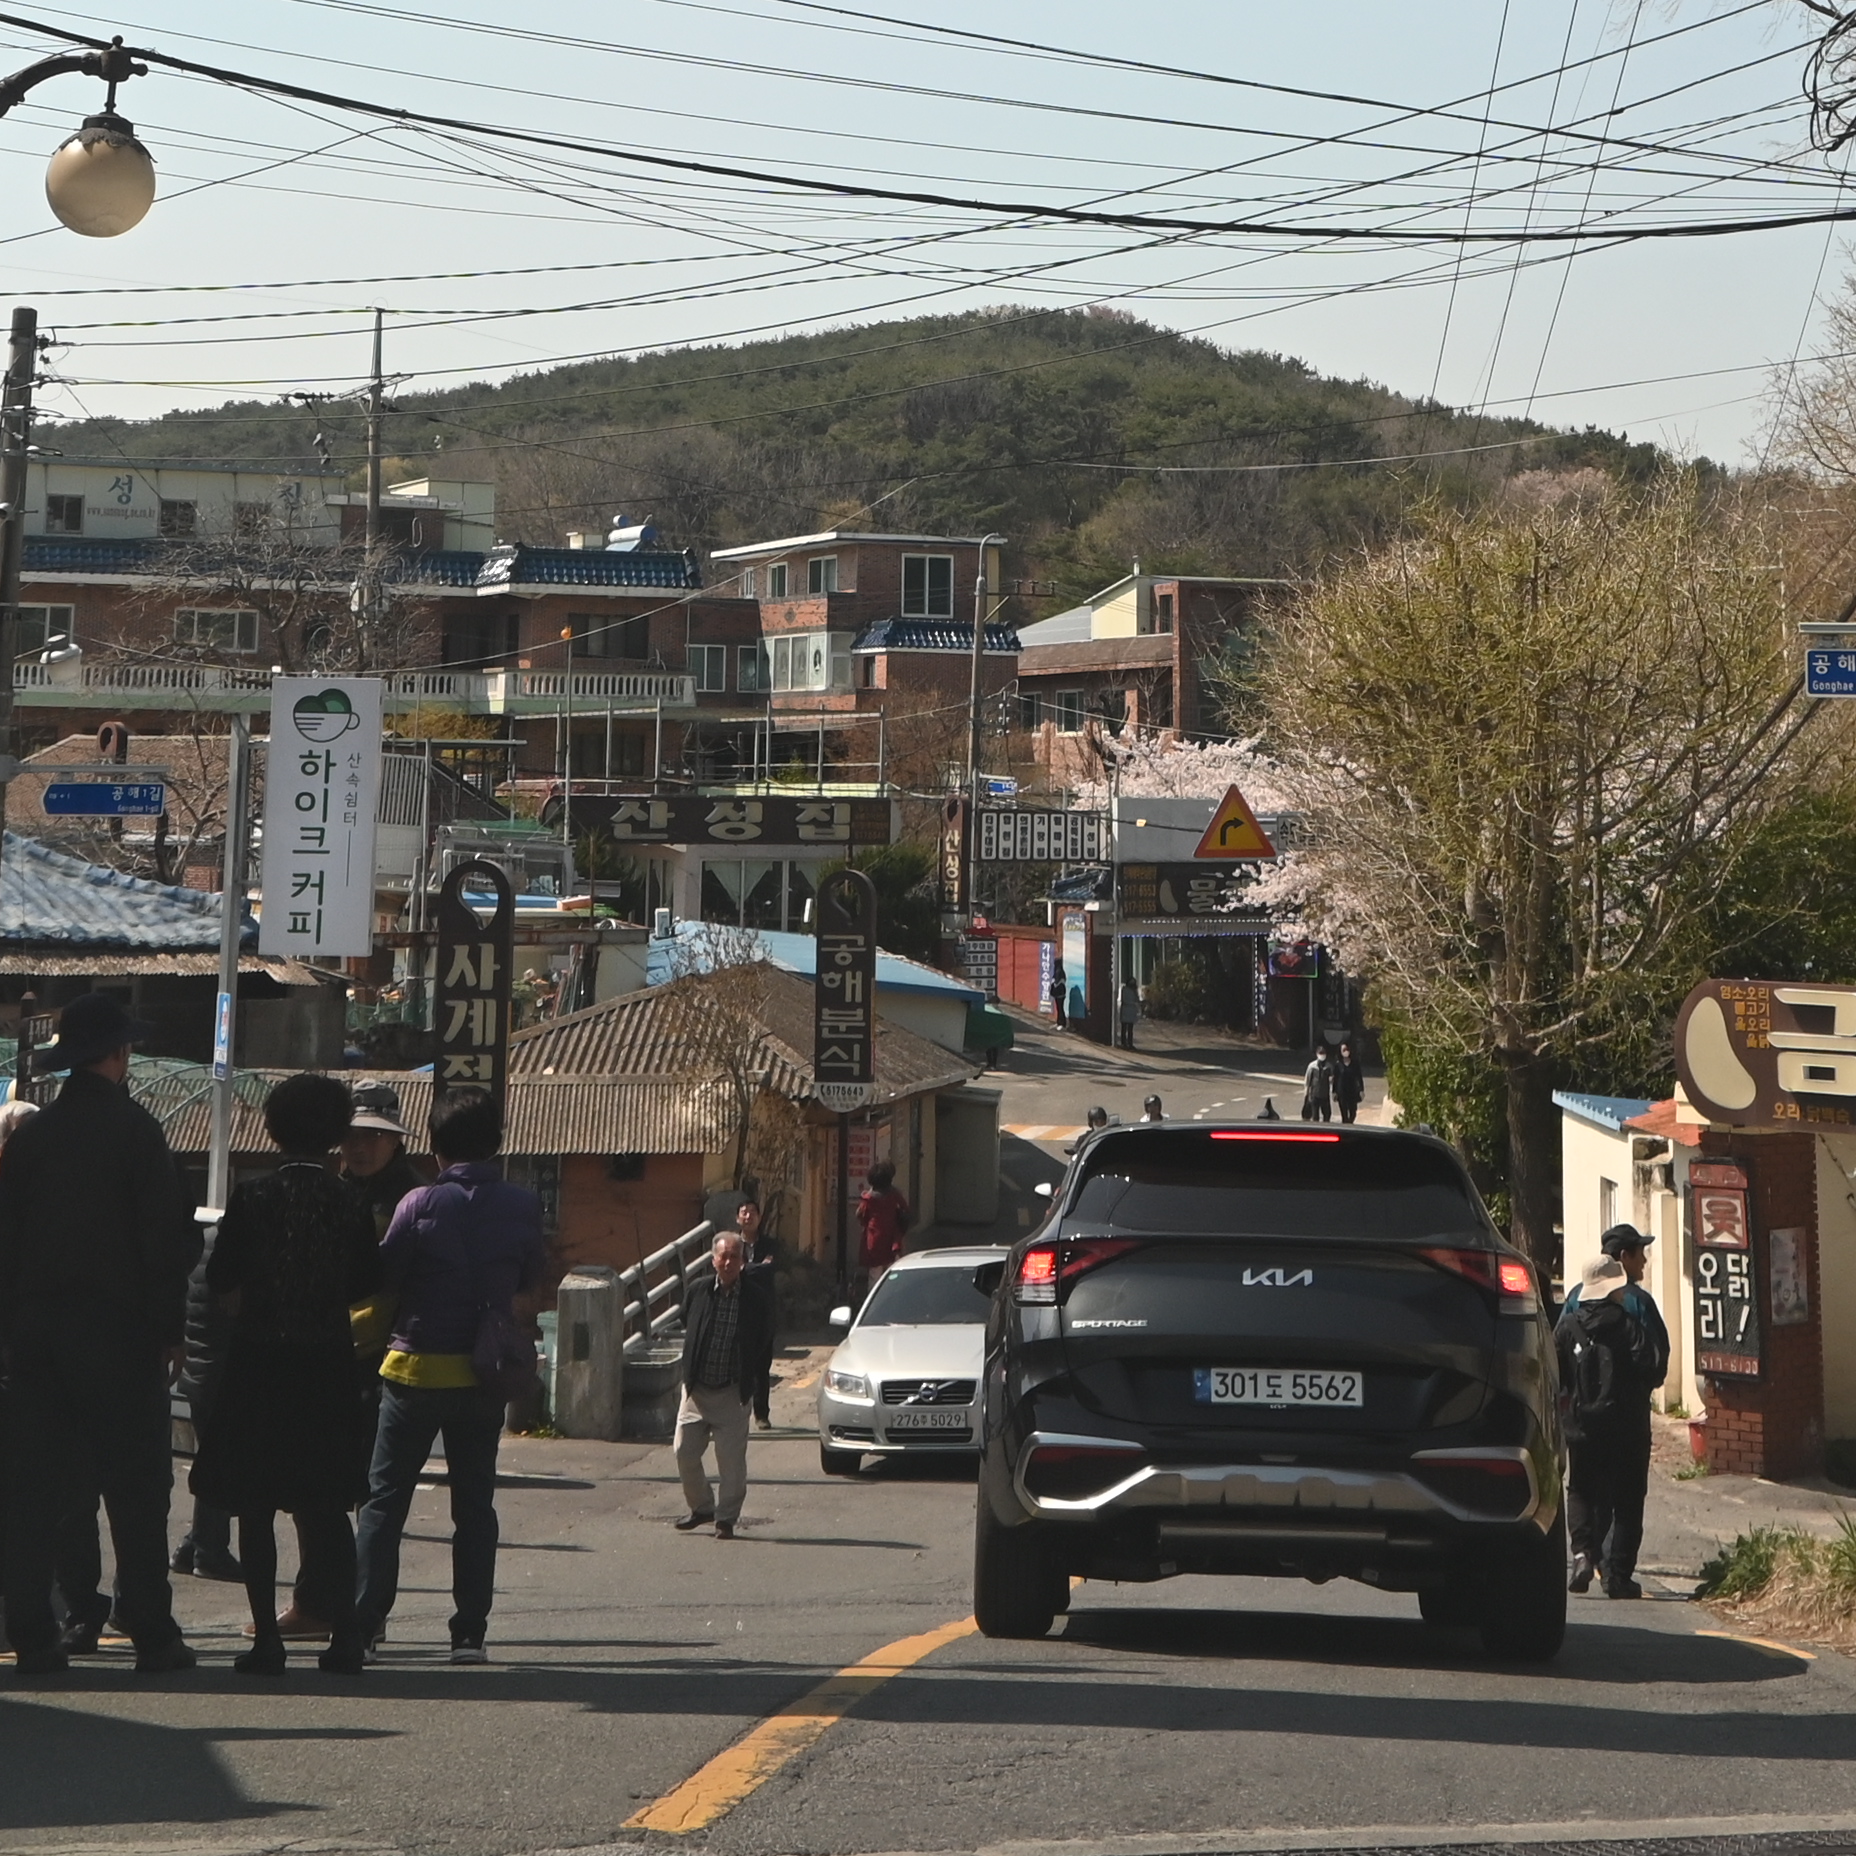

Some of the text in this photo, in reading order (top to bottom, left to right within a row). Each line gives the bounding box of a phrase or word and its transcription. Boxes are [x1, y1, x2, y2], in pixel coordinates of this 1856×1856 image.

[1812, 679, 1854, 693] Gonghae
[609, 800, 852, 841] 산성집
[287, 749, 337, 945] 하이크 커피
[945, 829, 961, 903] 산성집
[819, 934, 867, 1077] 공해분식
[1242, 1267, 1314, 1286] KIA
[1071, 1319, 1148, 1329] SPORTAGE
[1214, 1371, 1357, 1402] 301도 5562
[930, 1413, 962, 1427] 5029
